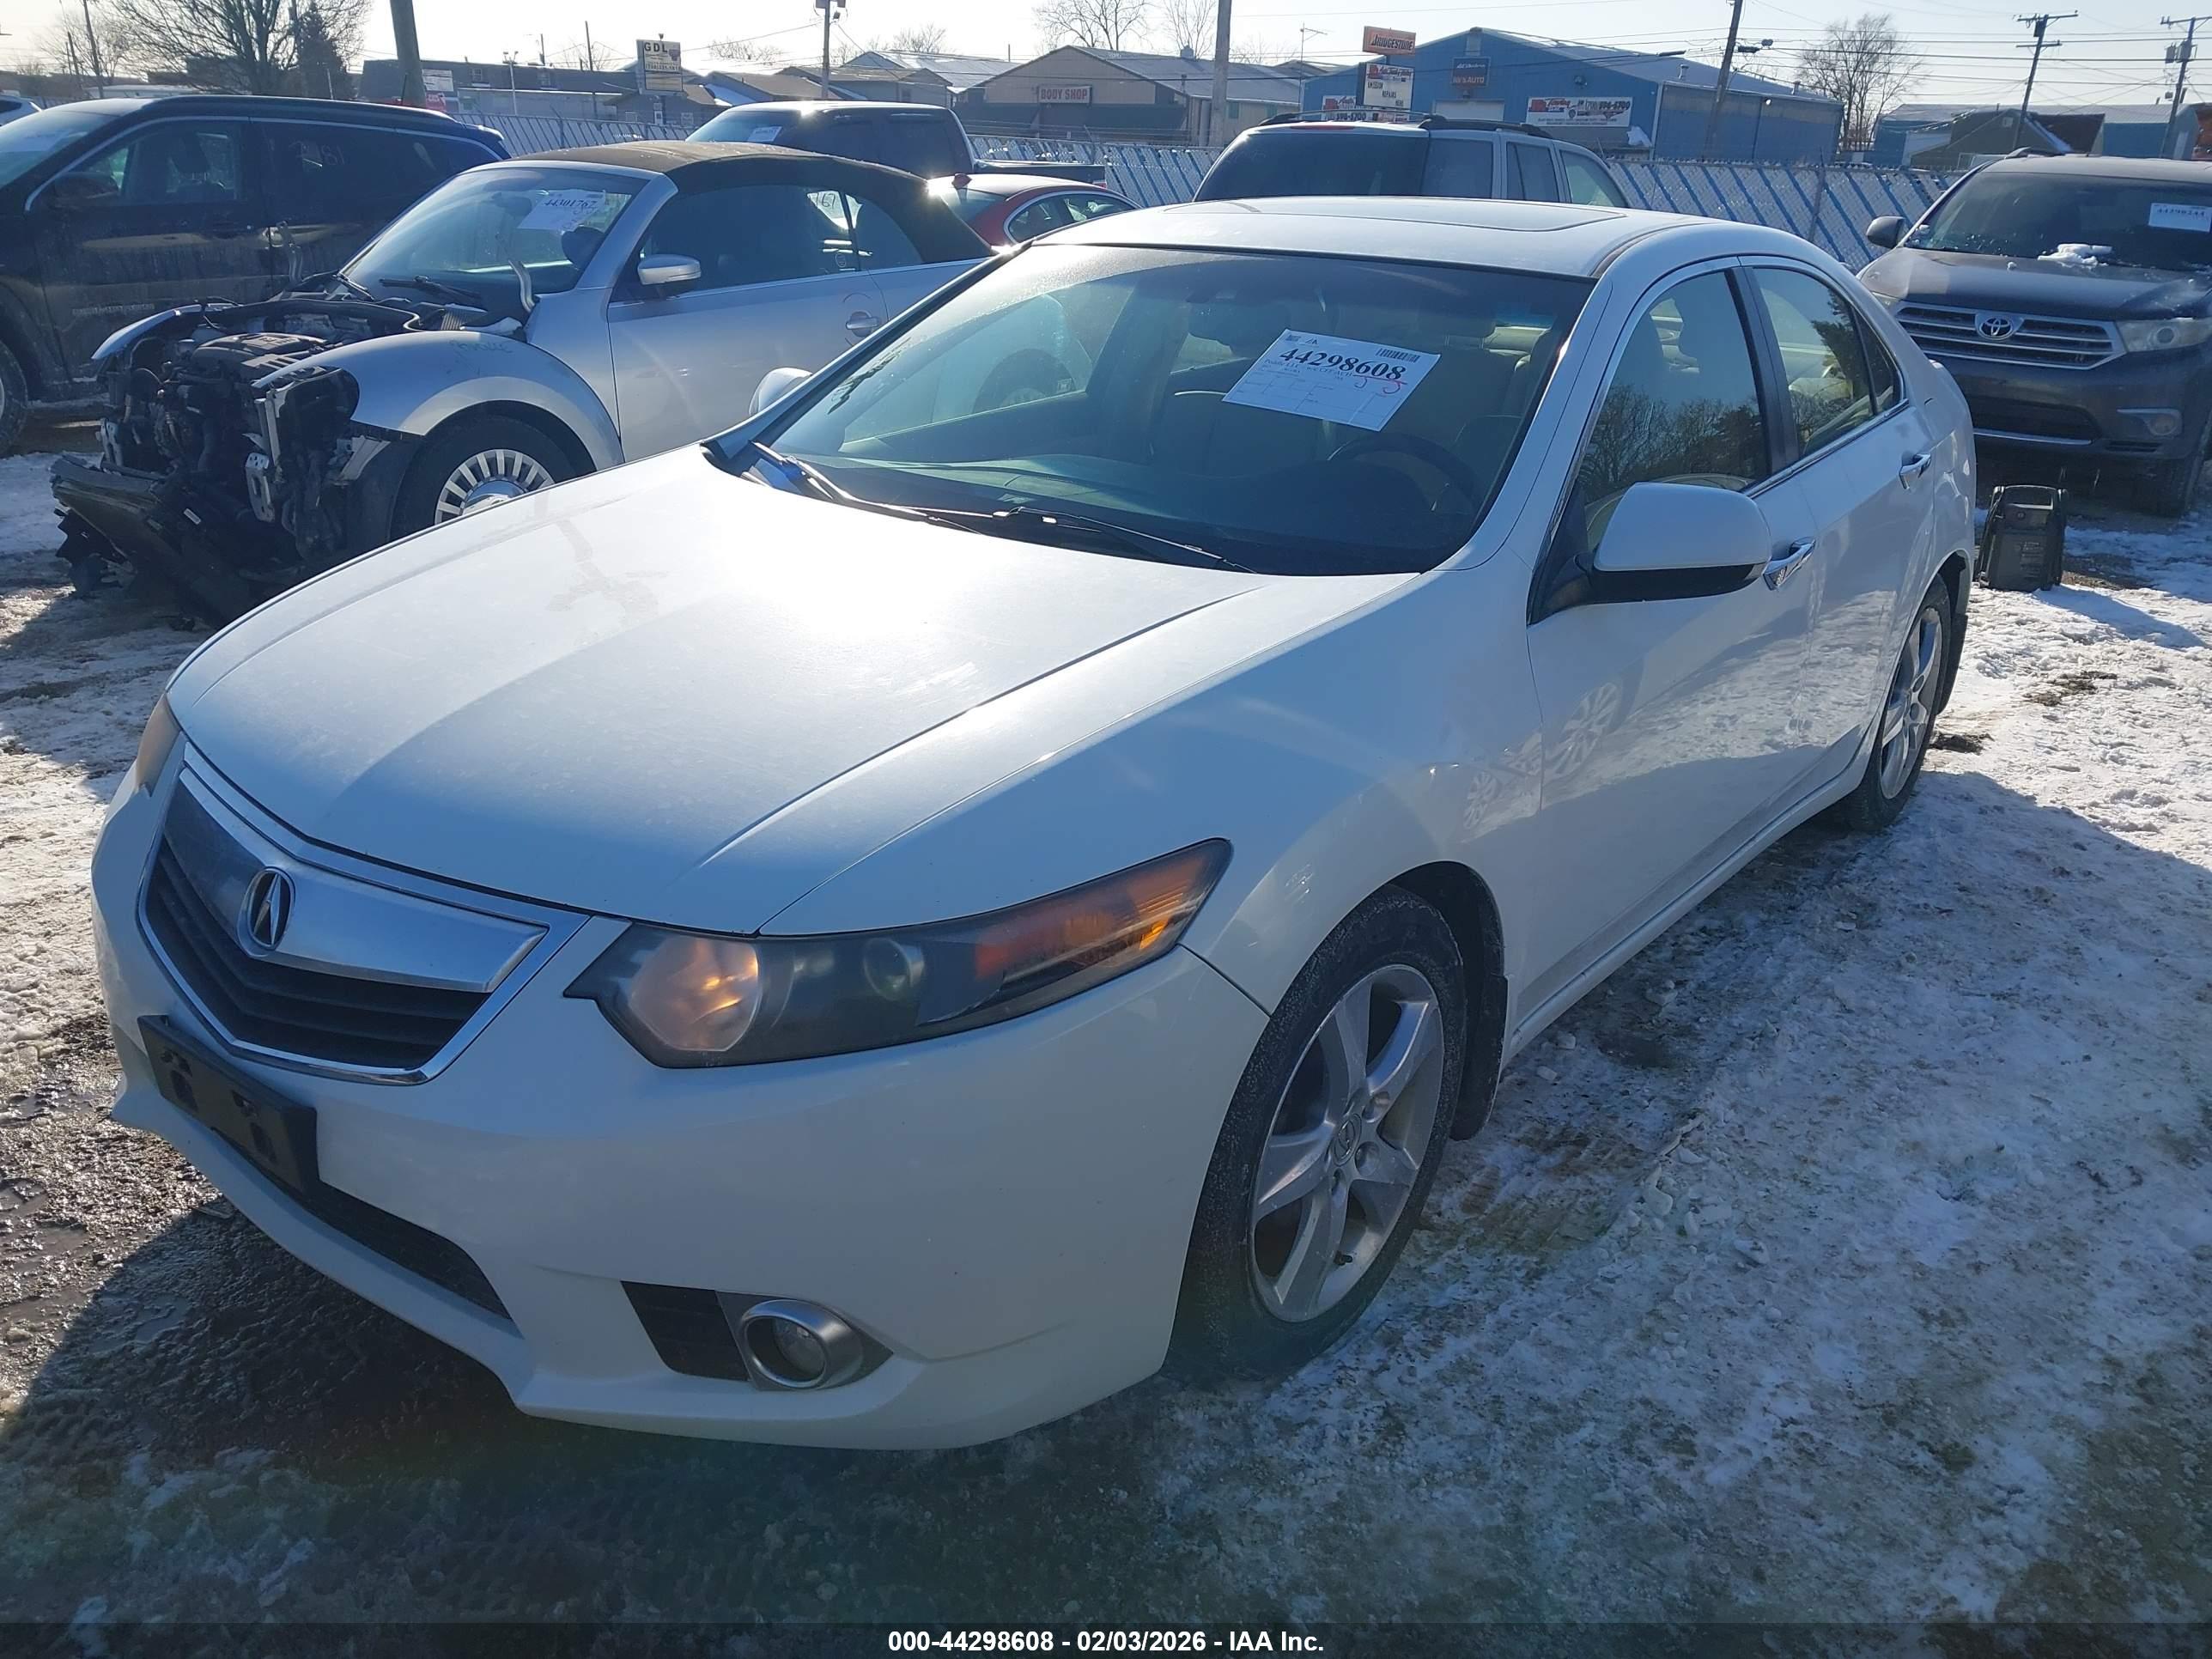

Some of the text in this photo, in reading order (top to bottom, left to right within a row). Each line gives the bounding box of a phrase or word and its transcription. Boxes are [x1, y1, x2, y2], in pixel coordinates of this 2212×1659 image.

[644, 42, 668, 52] GDL
[1041, 88, 1088, 100] BODY SHOP
[1279, 348, 1407, 380] 44298608
